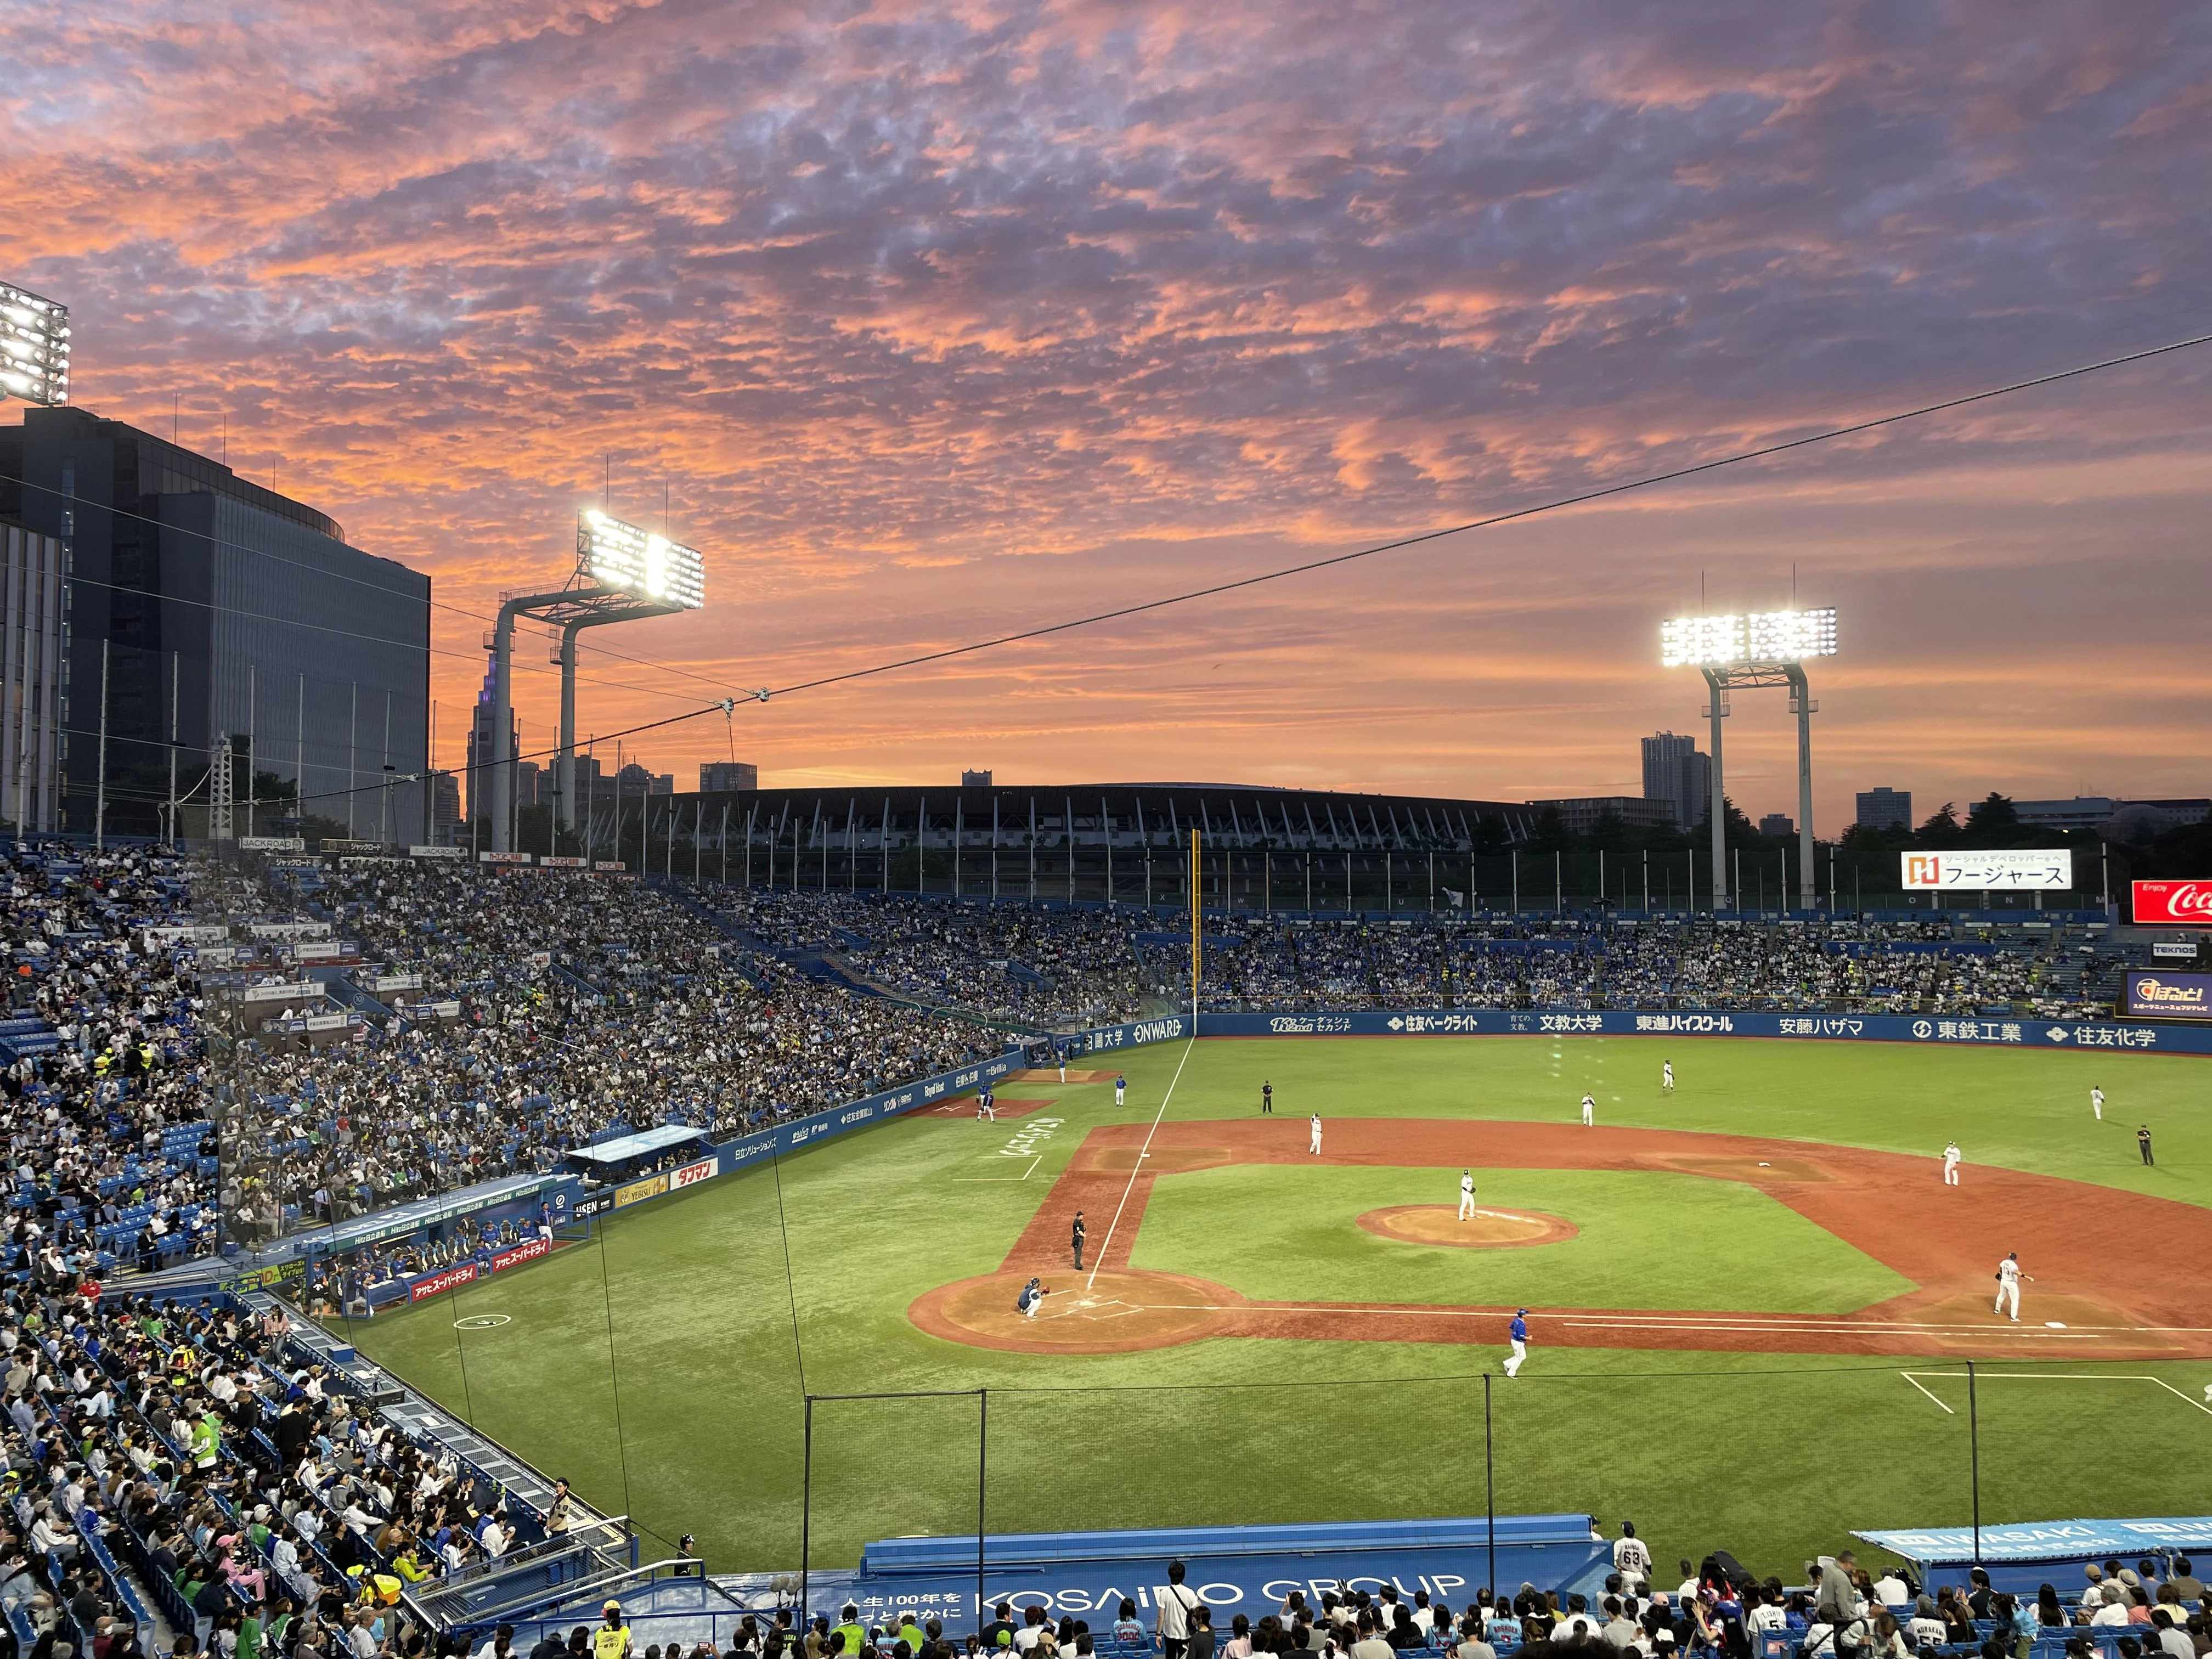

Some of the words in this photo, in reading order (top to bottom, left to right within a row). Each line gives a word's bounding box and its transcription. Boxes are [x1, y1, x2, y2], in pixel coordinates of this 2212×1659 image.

[1946, 865, 2064, 884] フージャース
[2142, 883, 2167, 893] Enjoy
[2168, 884, 2212, 916] Coc
[1133, 1019, 1182, 1043] ONWARD
[1317, 1024, 1352, 1032] セカンド
[1406, 1015, 1478, 1032] 住友ベークライト
[1539, 1014, 1602, 1031] 文教大学
[1636, 1015, 1733, 1032] 東進ハイスクール
[1779, 1018, 1863, 1036] 安藤ハザマ
[1938, 1020, 2022, 1042] 東鉄工業
[2073, 1026, 2156, 1047] 住友化学
[991, 1063, 1007, 1076] Brillia
[924, 1083, 935, 1098] Royal
[935, 1081, 945, 1094] Host
[735, 1136, 777, 1161] 日立ソリューションズ
[679, 1161, 710, 1186] タフマン
[631, 1187, 651, 1201] YEBISU
[576, 1200, 597, 1217] USEN
[496, 1241, 546, 1269] アサヒスーパードライ
[415, 1267, 474, 1298] アサヒスーパードライ
[1937, 1526, 2096, 1545] IWASAKI
[1624, 1551, 1639, 1565] 63
[1262, 1575, 1465, 1602] GROUP
[839, 1593, 962, 1608] 人生100年を
